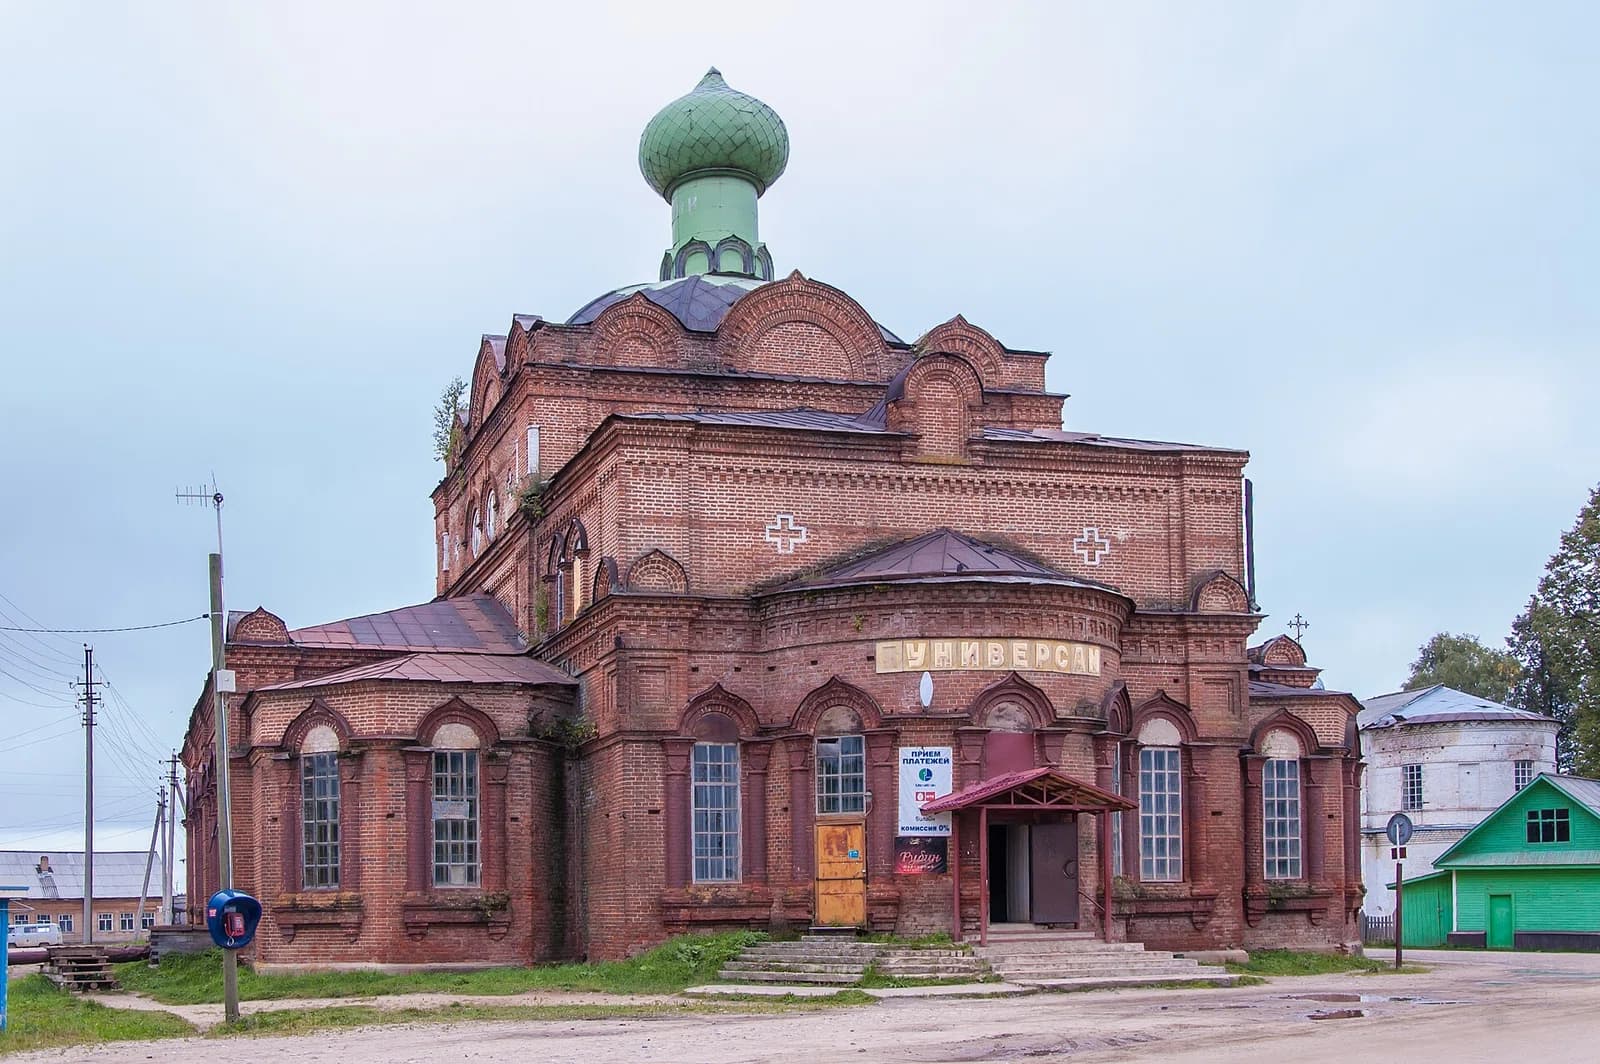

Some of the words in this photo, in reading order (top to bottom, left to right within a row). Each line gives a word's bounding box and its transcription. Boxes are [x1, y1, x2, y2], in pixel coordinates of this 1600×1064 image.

[905, 641, 1100, 673] УНИВЕРСАМ
[902, 757, 950, 765] ПЛАТЕЖЕЙ
[938, 824, 950, 832] 0%
